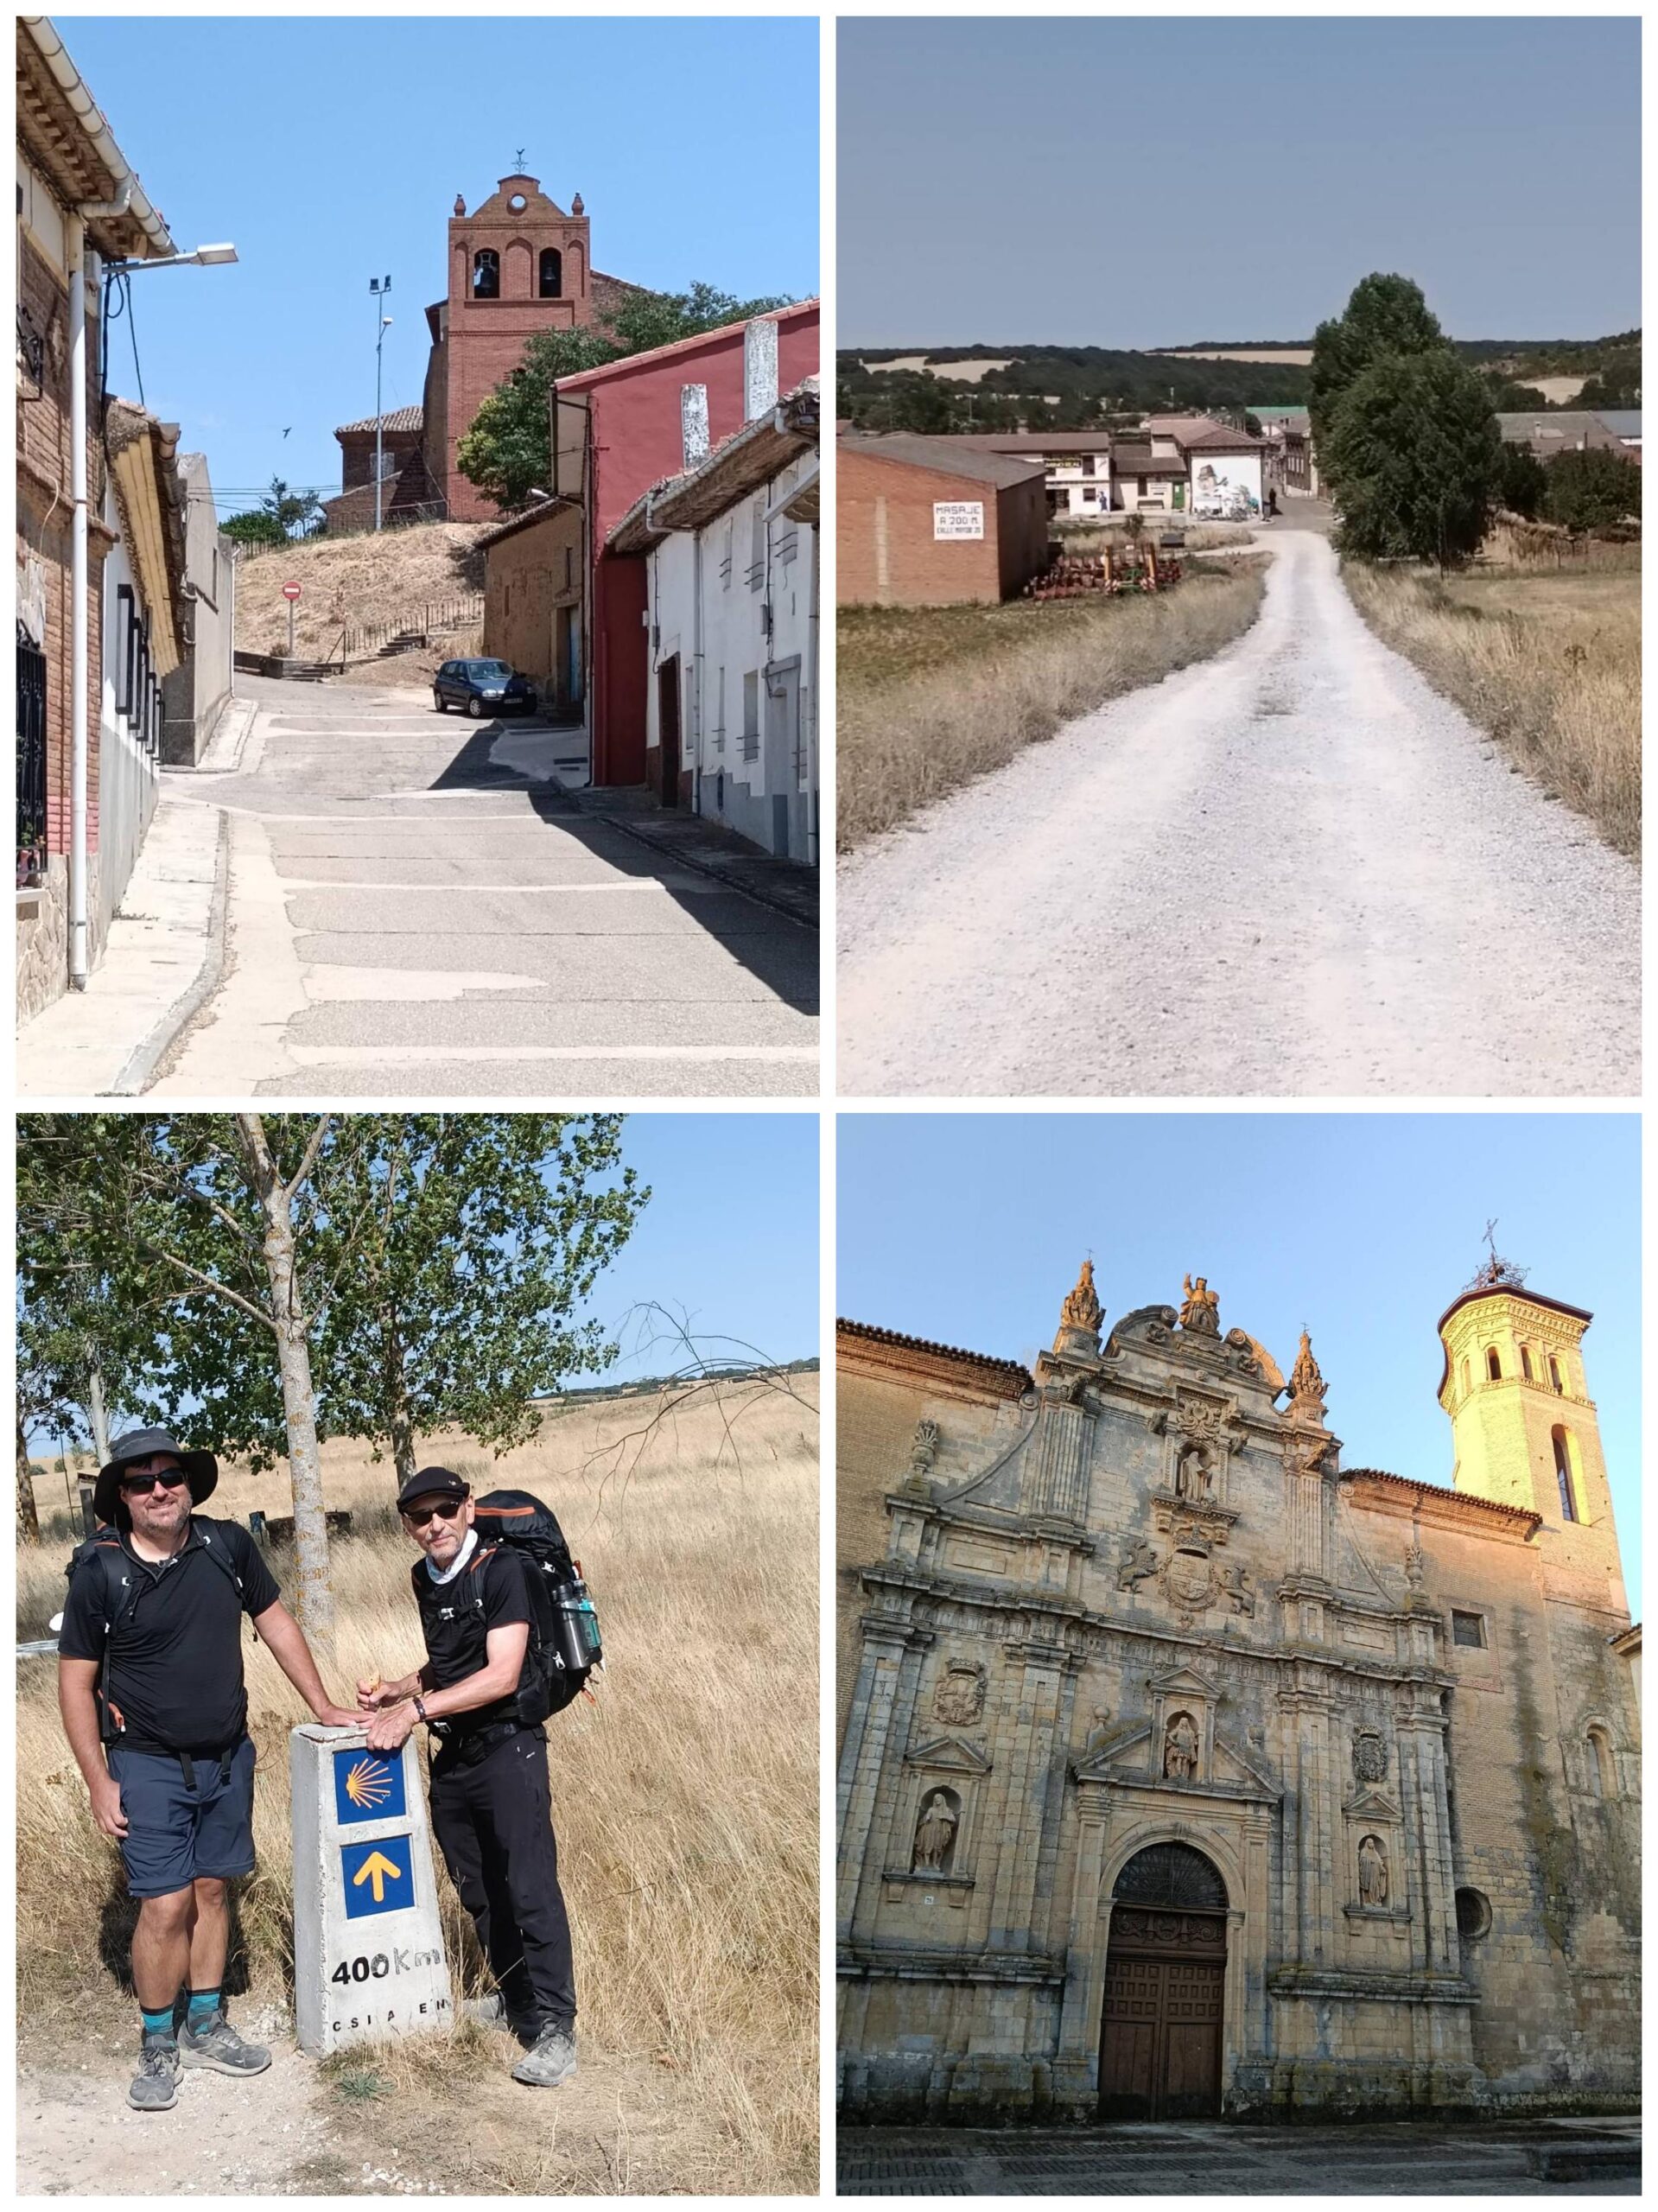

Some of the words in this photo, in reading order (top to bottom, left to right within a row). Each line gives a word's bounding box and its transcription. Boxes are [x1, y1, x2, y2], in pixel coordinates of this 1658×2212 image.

[936, 505, 981, 515] MASAJE
[940, 516, 946, 525] A
[950, 516, 969, 524] 200
